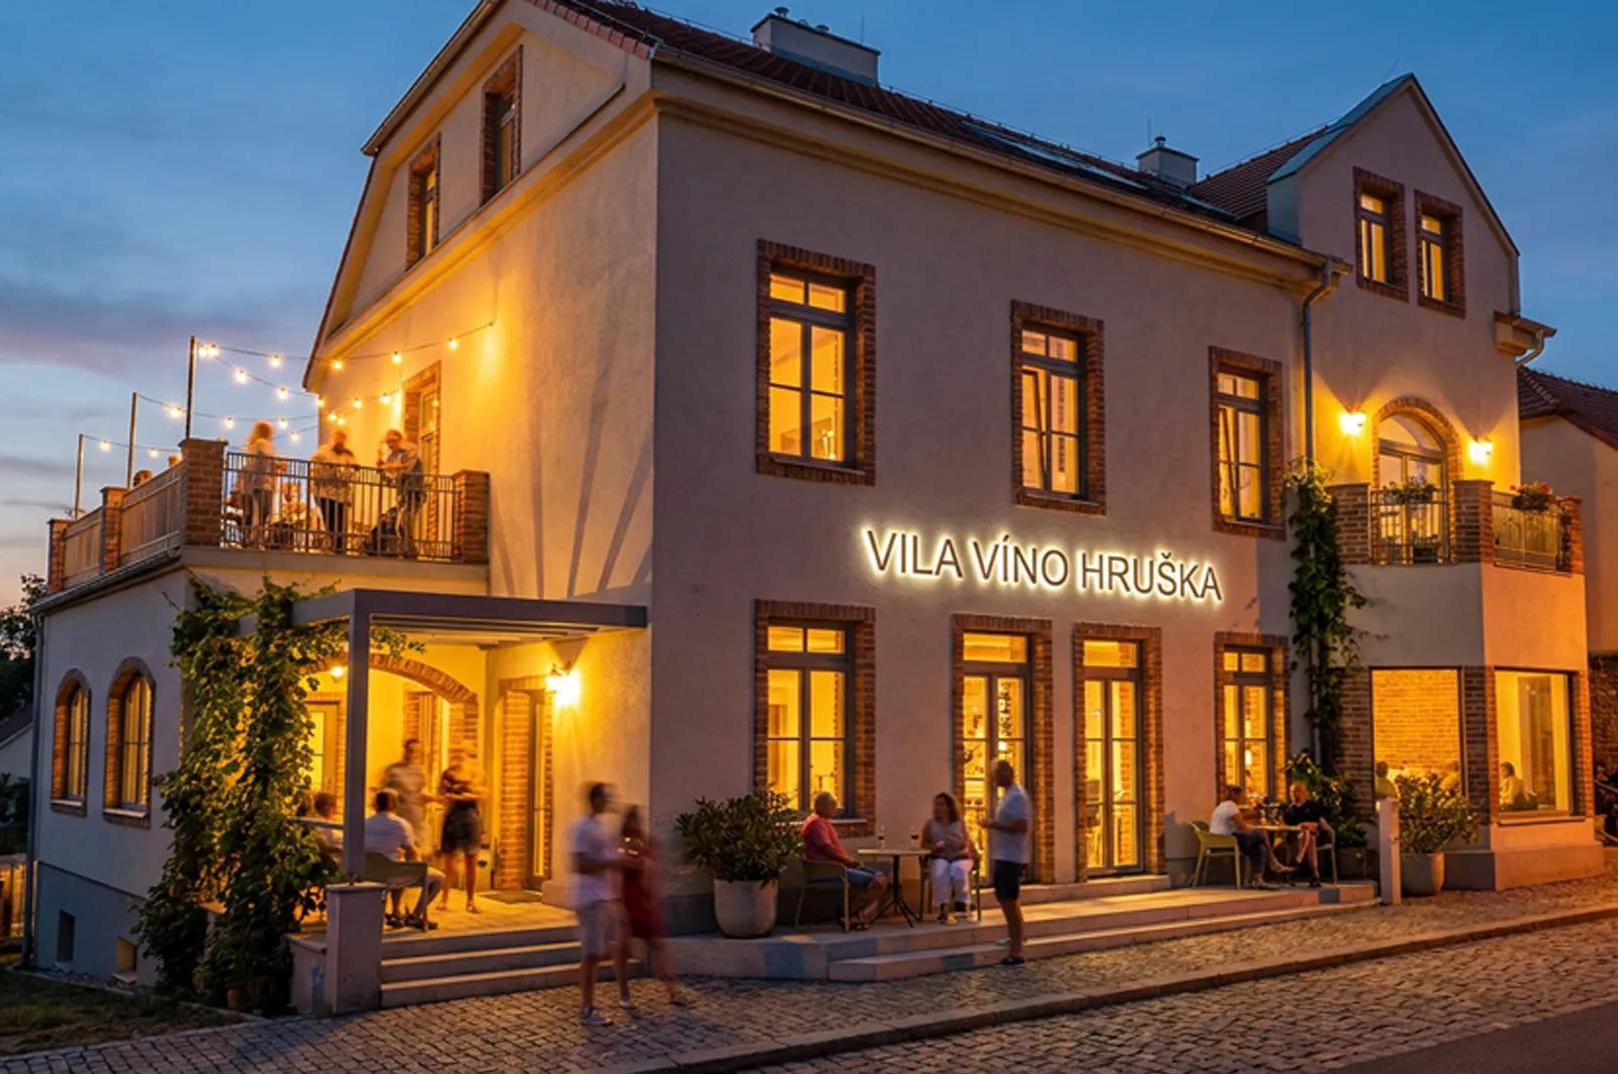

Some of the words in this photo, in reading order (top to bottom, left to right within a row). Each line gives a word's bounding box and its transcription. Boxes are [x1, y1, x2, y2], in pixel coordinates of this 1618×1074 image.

[867, 530, 963, 579] VILA
[972, 534, 1068, 586] VÍNO
[1081, 552, 1222, 600] HRUŠKA
